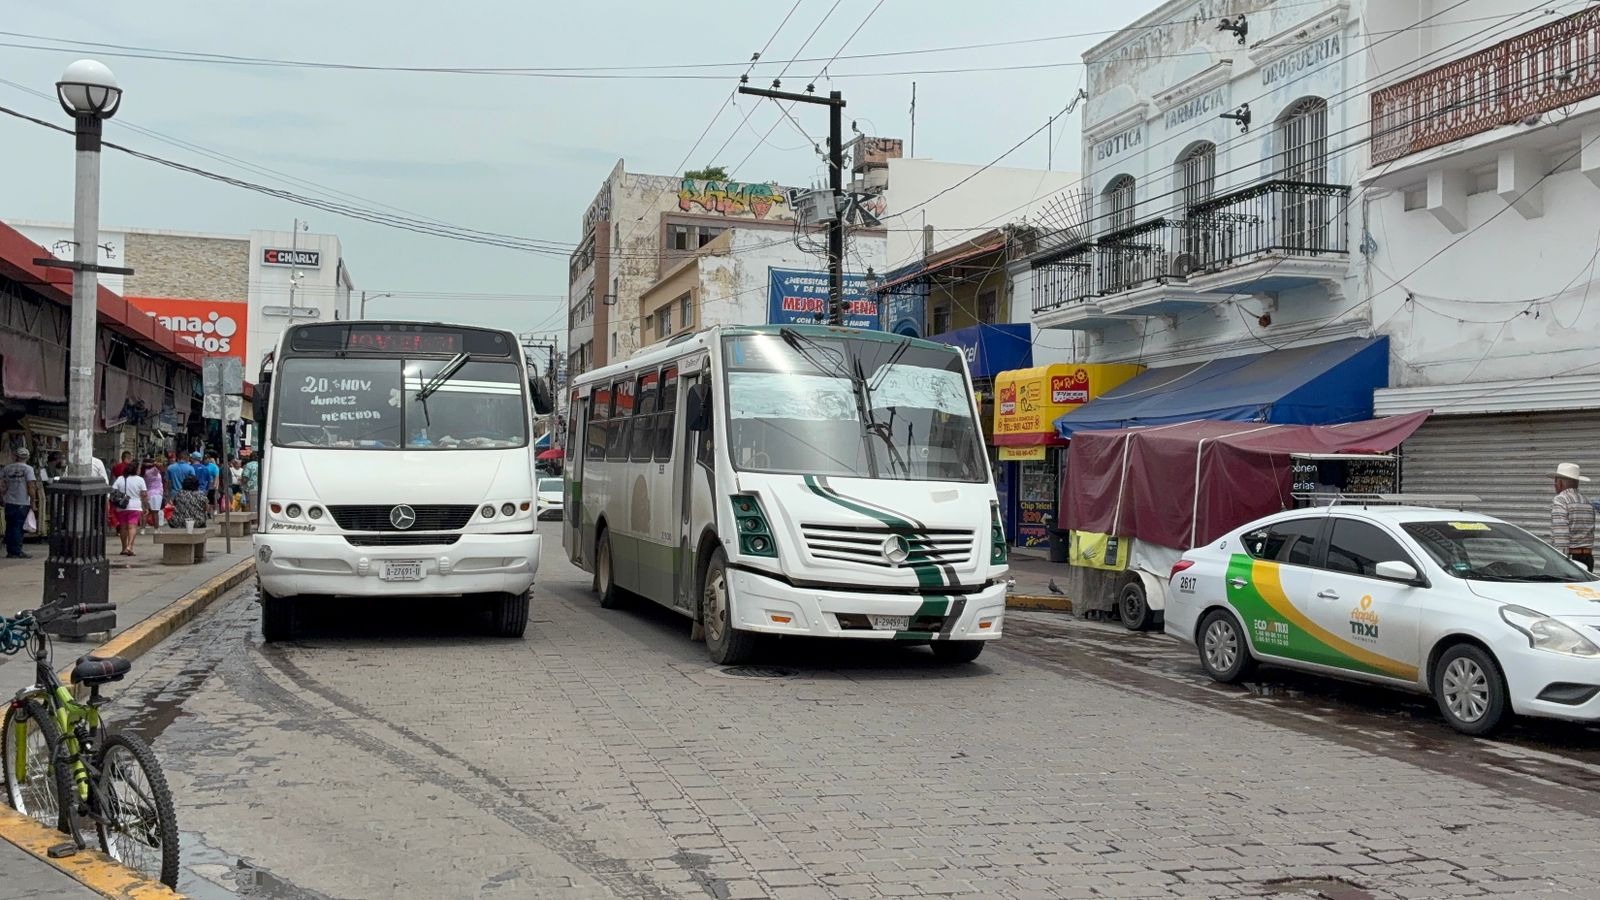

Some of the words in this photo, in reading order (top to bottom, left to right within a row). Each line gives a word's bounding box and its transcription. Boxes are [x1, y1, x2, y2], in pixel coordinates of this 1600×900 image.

[1097, 128, 1143, 161] BOTICA
[278, 251, 318, 264] CHARLY
[783, 297, 823, 313] MEJOR
[145, 311, 202, 332] ana
[1021, 502, 1035, 511] Chip
[1180, 576, 1197, 590] 2617
[1349, 620, 1379, 639] TAXI
